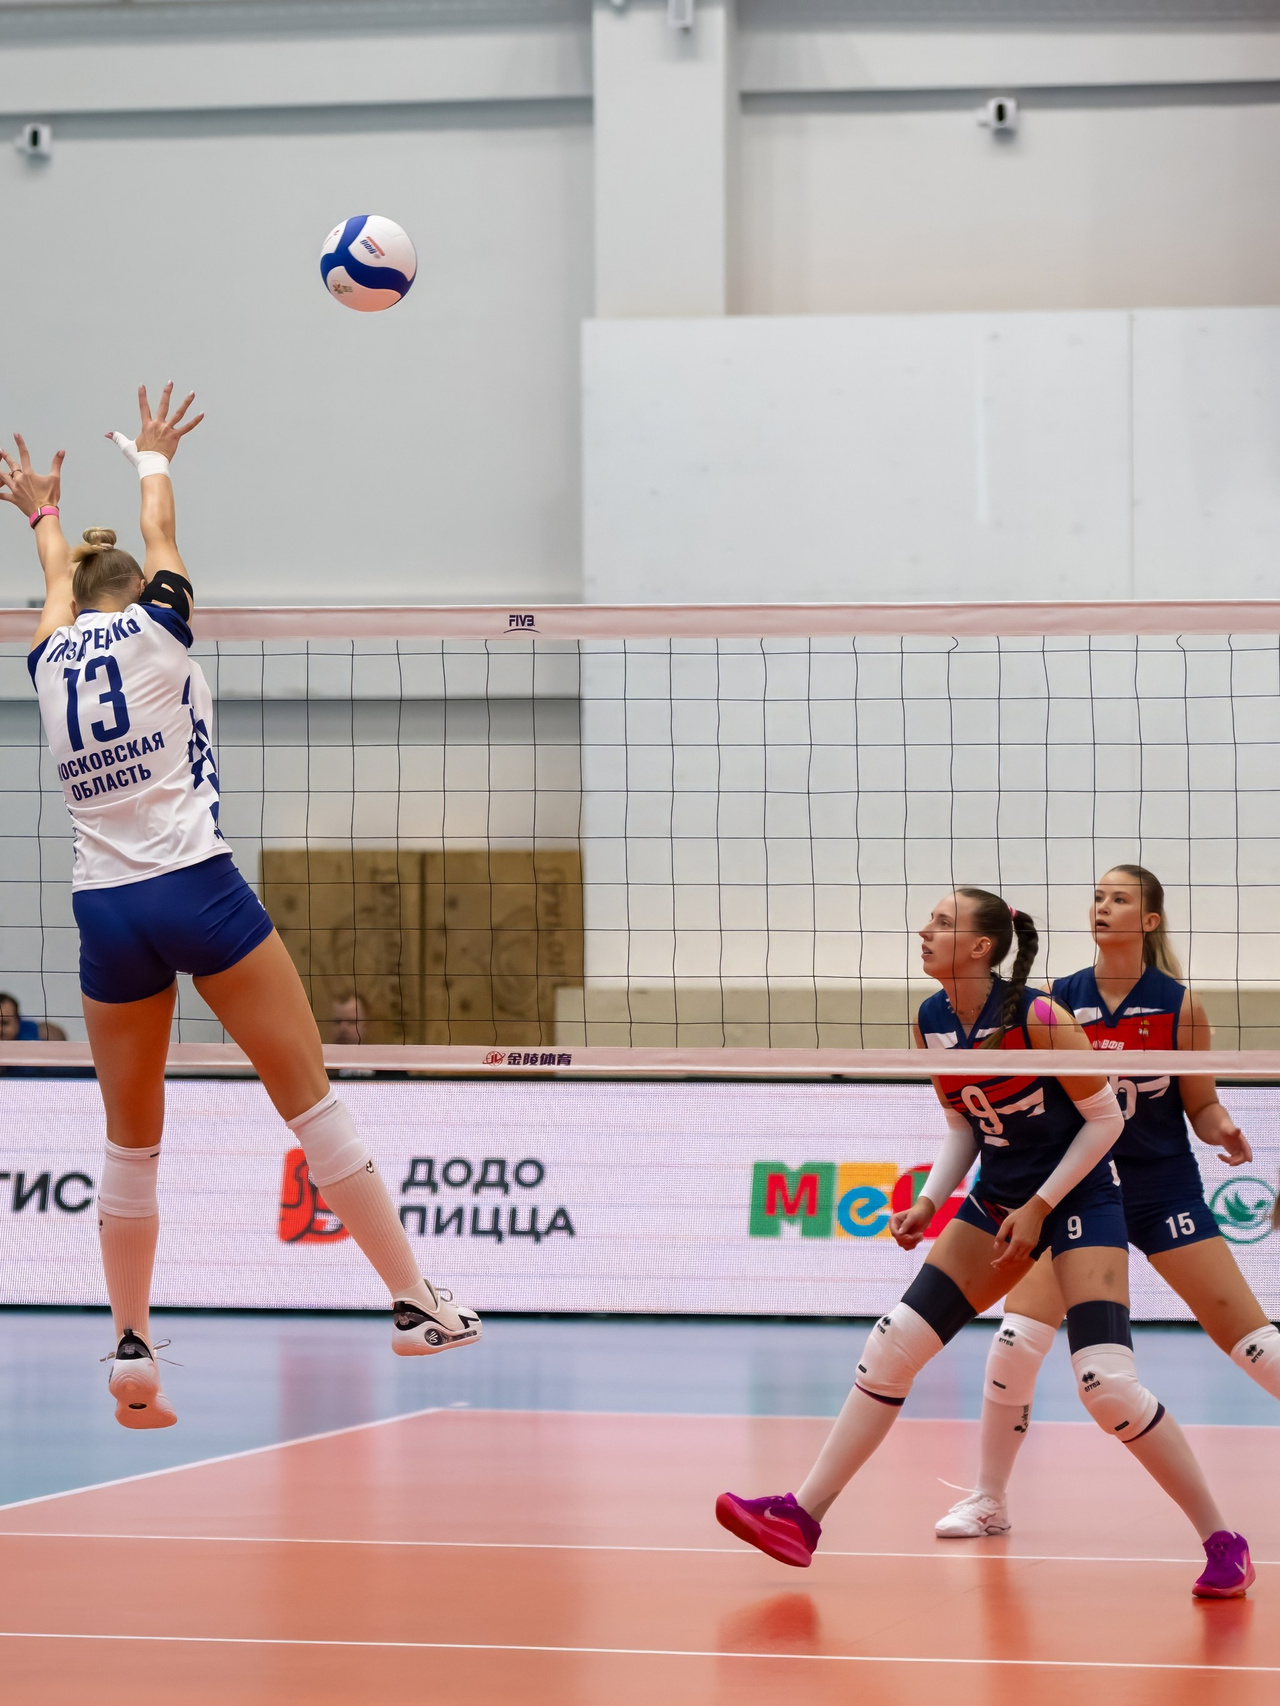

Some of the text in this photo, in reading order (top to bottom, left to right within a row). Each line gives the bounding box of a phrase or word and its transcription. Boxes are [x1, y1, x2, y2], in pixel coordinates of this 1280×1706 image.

[509, 615, 534, 627] FIVB
[63, 654, 131, 752] 13
[58, 731, 165, 781] ОСКОВСКАЯ
[71, 763, 152, 802] ОБЛАСТЬ
[507, 1053, 572, 1066] 金陵体育
[960, 1085, 1004, 1136] 9
[402, 1158, 545, 1195] ДОДО
[400, 1205, 575, 1243] ПИЦЦА
[1067, 1215, 1083, 1239] 9
[1165, 1212, 1196, 1239] 15
